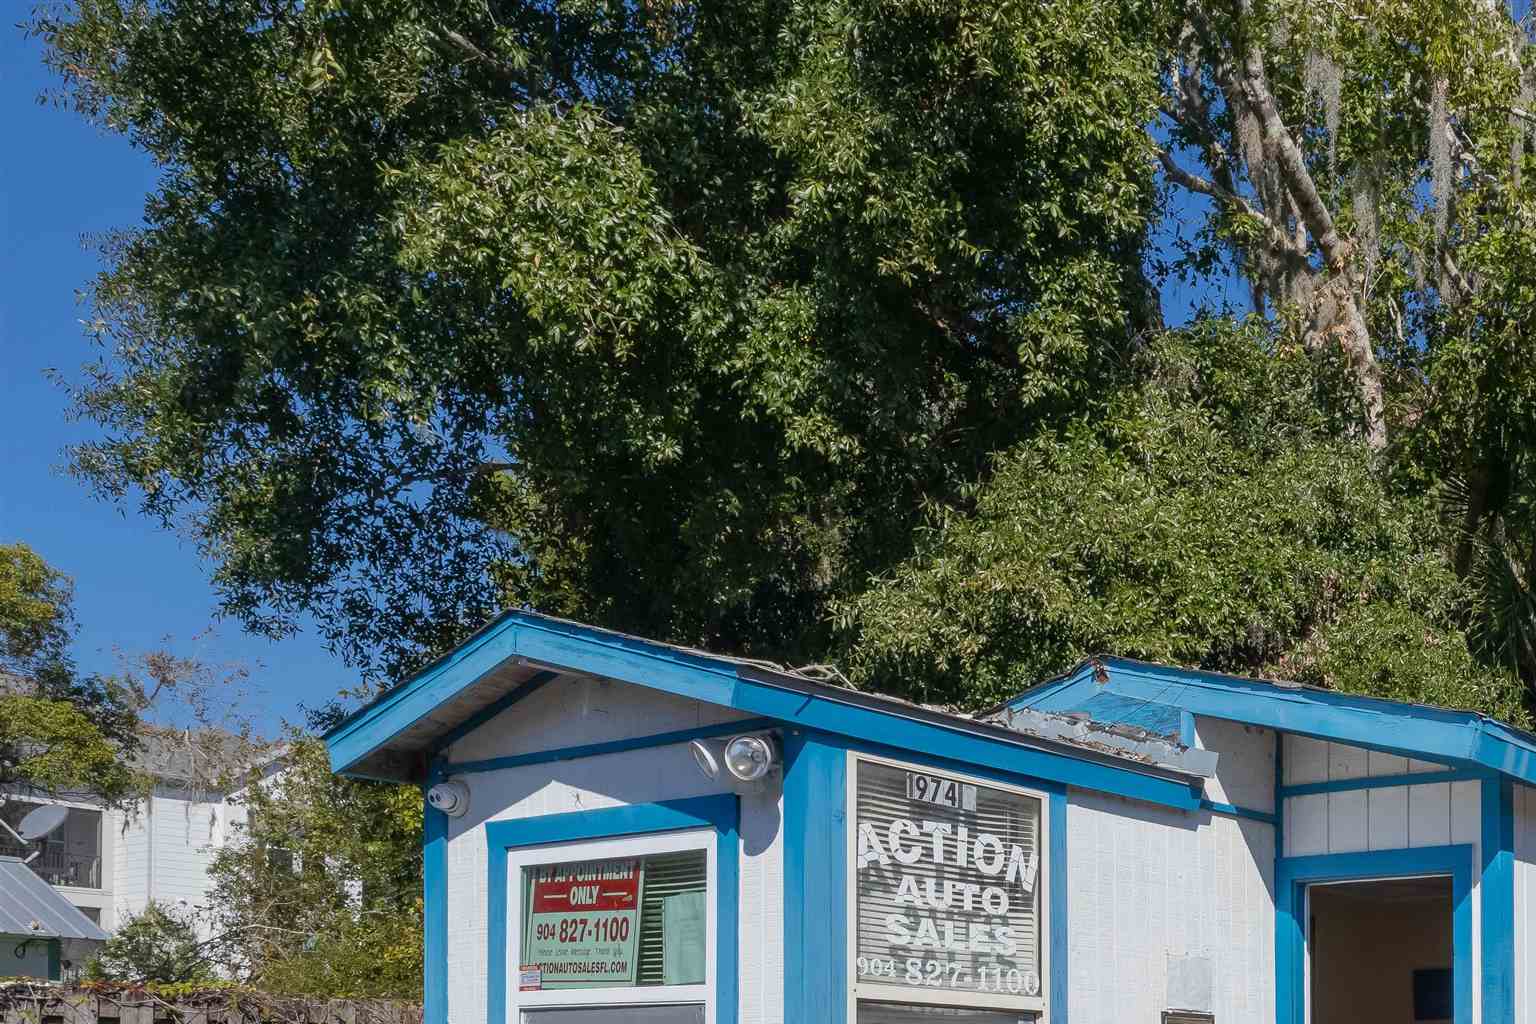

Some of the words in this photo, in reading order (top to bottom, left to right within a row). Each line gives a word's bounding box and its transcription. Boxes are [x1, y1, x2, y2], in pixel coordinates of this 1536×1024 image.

[857, 818, 1039, 893] ACTION
[569, 885, 600, 906] ONLY
[894, 875, 1010, 916] AUTO
[536, 923, 556, 941] 904
[886, 914, 1017, 956] SALES
[856, 956, 897, 978] 904
